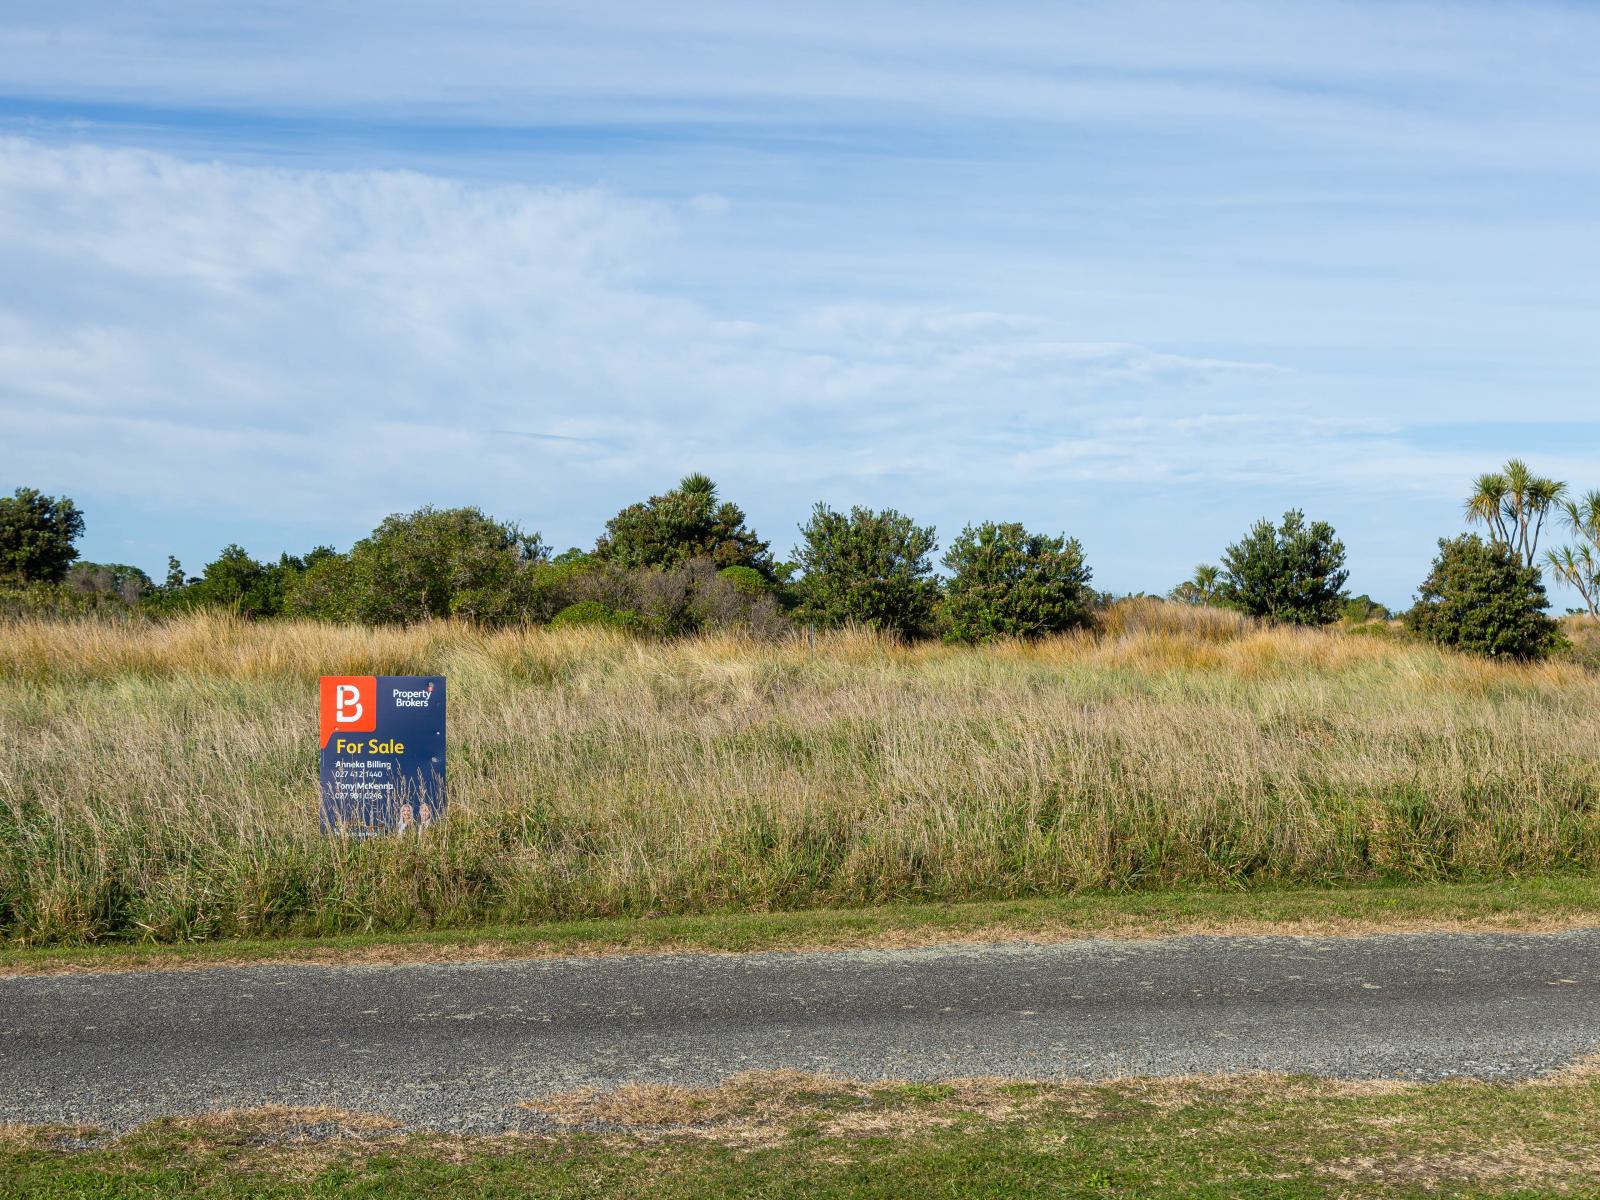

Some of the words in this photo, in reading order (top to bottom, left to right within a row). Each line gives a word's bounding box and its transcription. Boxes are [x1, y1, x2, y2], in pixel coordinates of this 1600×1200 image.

[392, 689, 432, 700] Property
[336, 685, 363, 722] B
[396, 699, 429, 707] Brokers
[336, 739, 364, 754] For
[368, 739, 405, 754] Sale
[366, 761, 391, 770] Billing
[335, 782, 355, 791] Tony
[357, 782, 394, 790] McKenna
